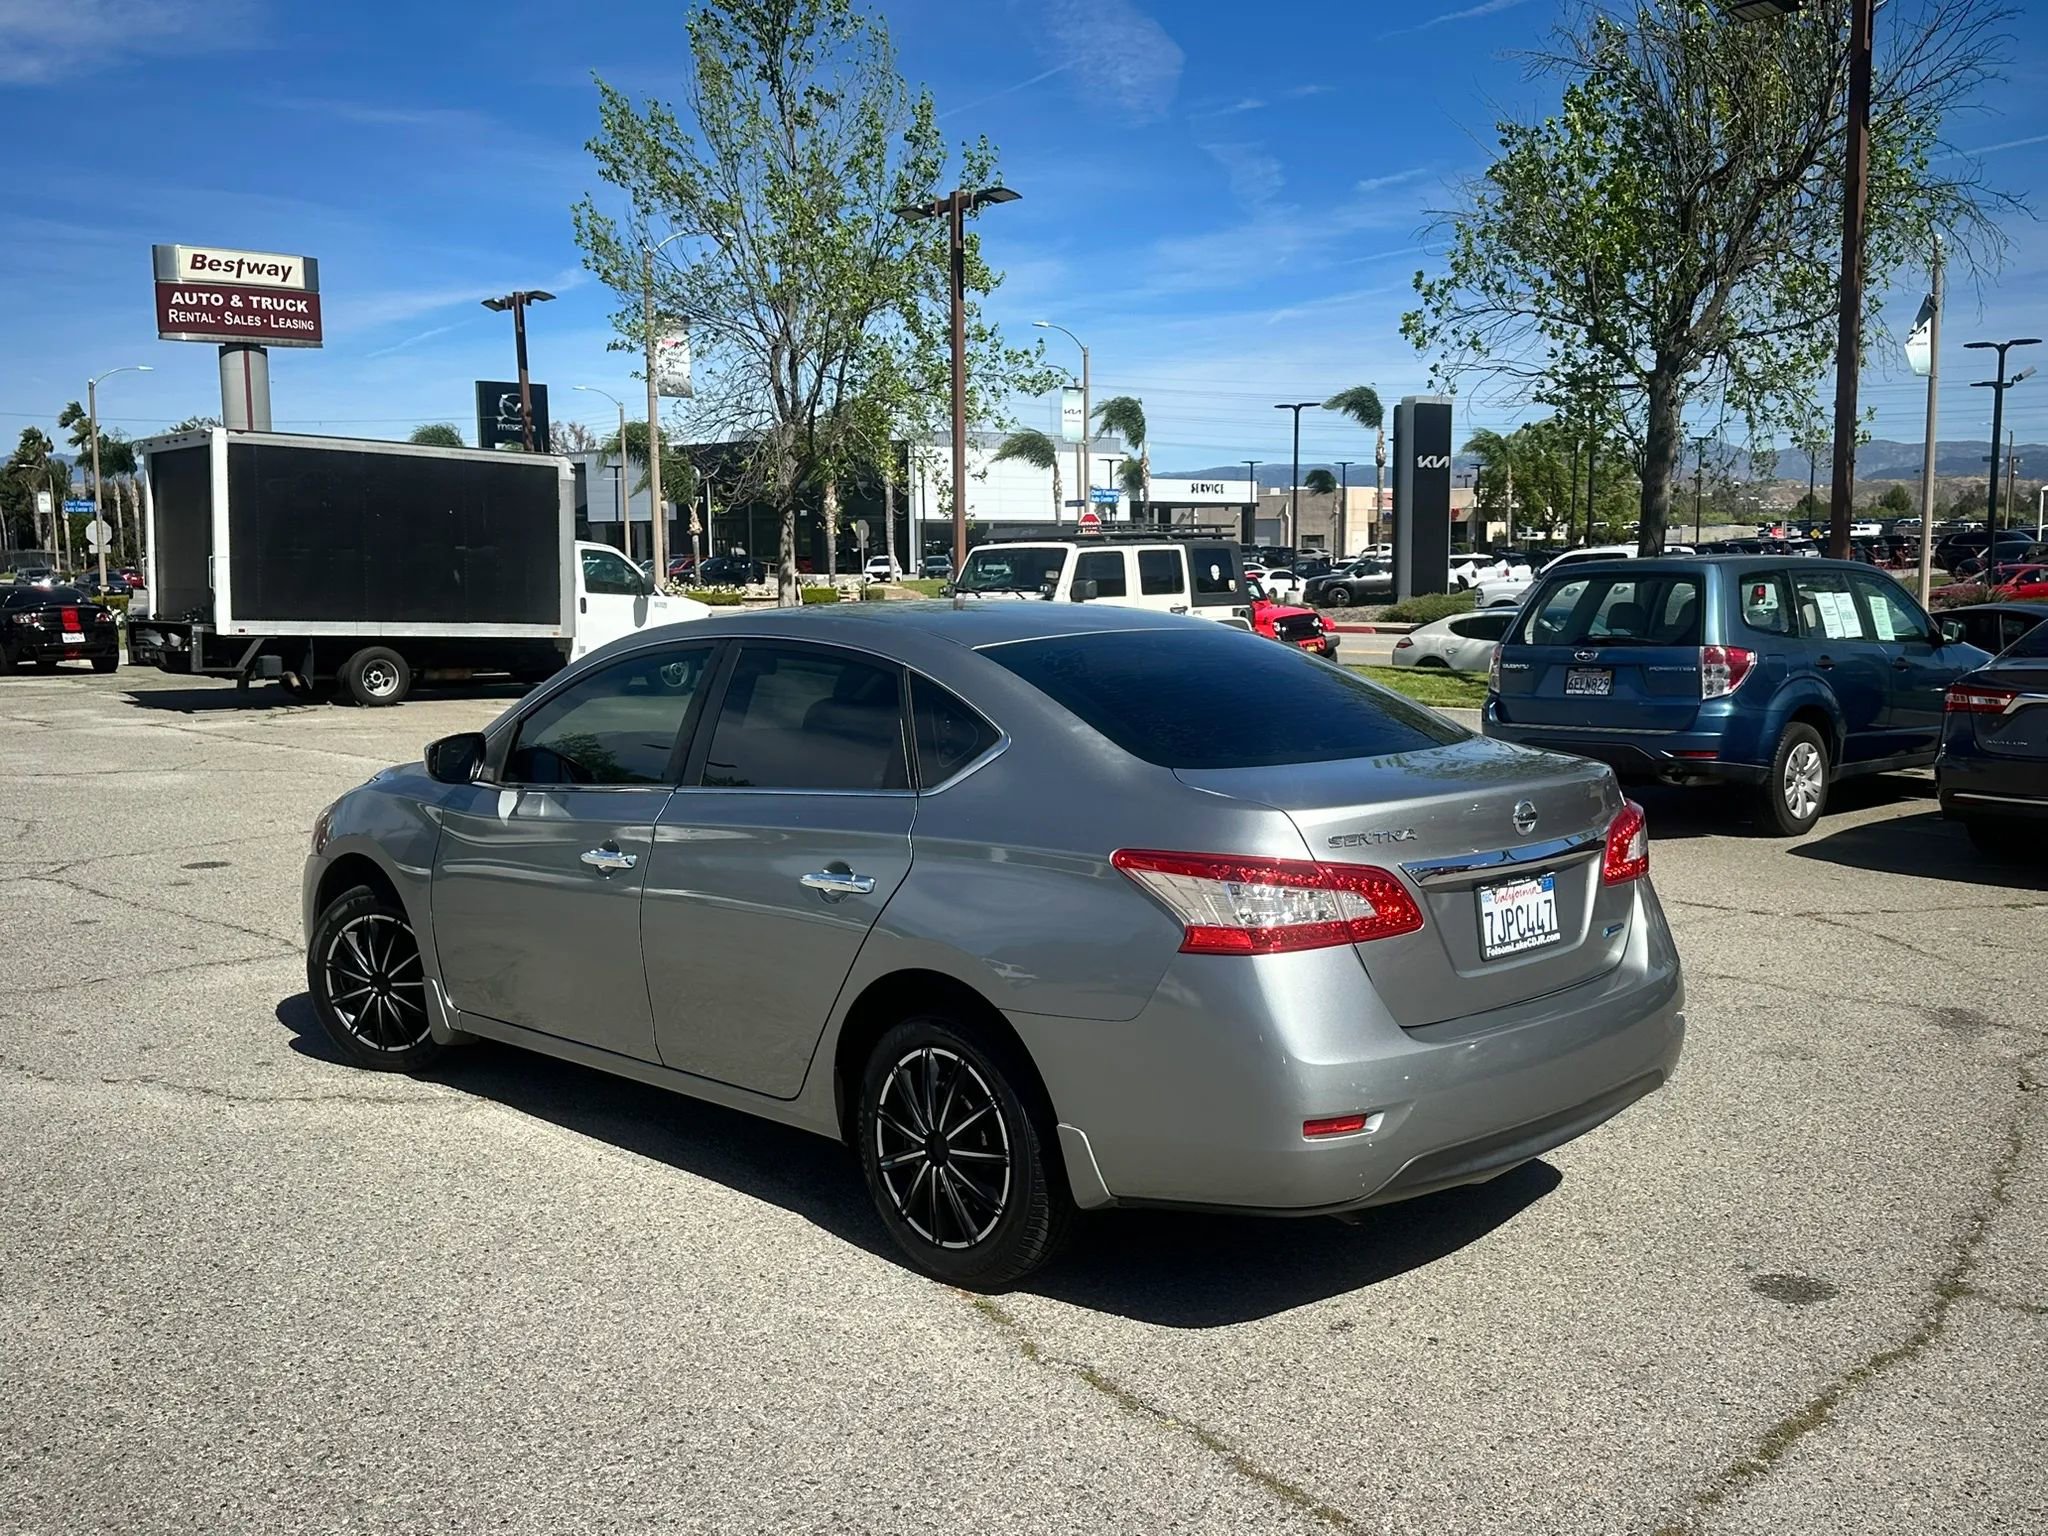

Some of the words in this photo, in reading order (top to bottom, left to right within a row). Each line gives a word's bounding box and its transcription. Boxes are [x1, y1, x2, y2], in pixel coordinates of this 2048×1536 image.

[190, 253, 293, 282] Bestway
[171, 291, 224, 305] AUTO
[230, 294, 244, 308] &
[249, 296, 309, 313] TRUCK
[168, 308, 216, 324] RENTAL
[224, 311, 262, 327] SALES
[270, 314, 315, 331] LEASING
[1417, 455, 1450, 469] KIA
[1190, 482, 1225, 495] SERVICE
[1494, 885, 1539, 905] California
[1484, 898, 1553, 946] 7JPC447
[1486, 932, 1561, 957] FolsomLakeCDJR.com
